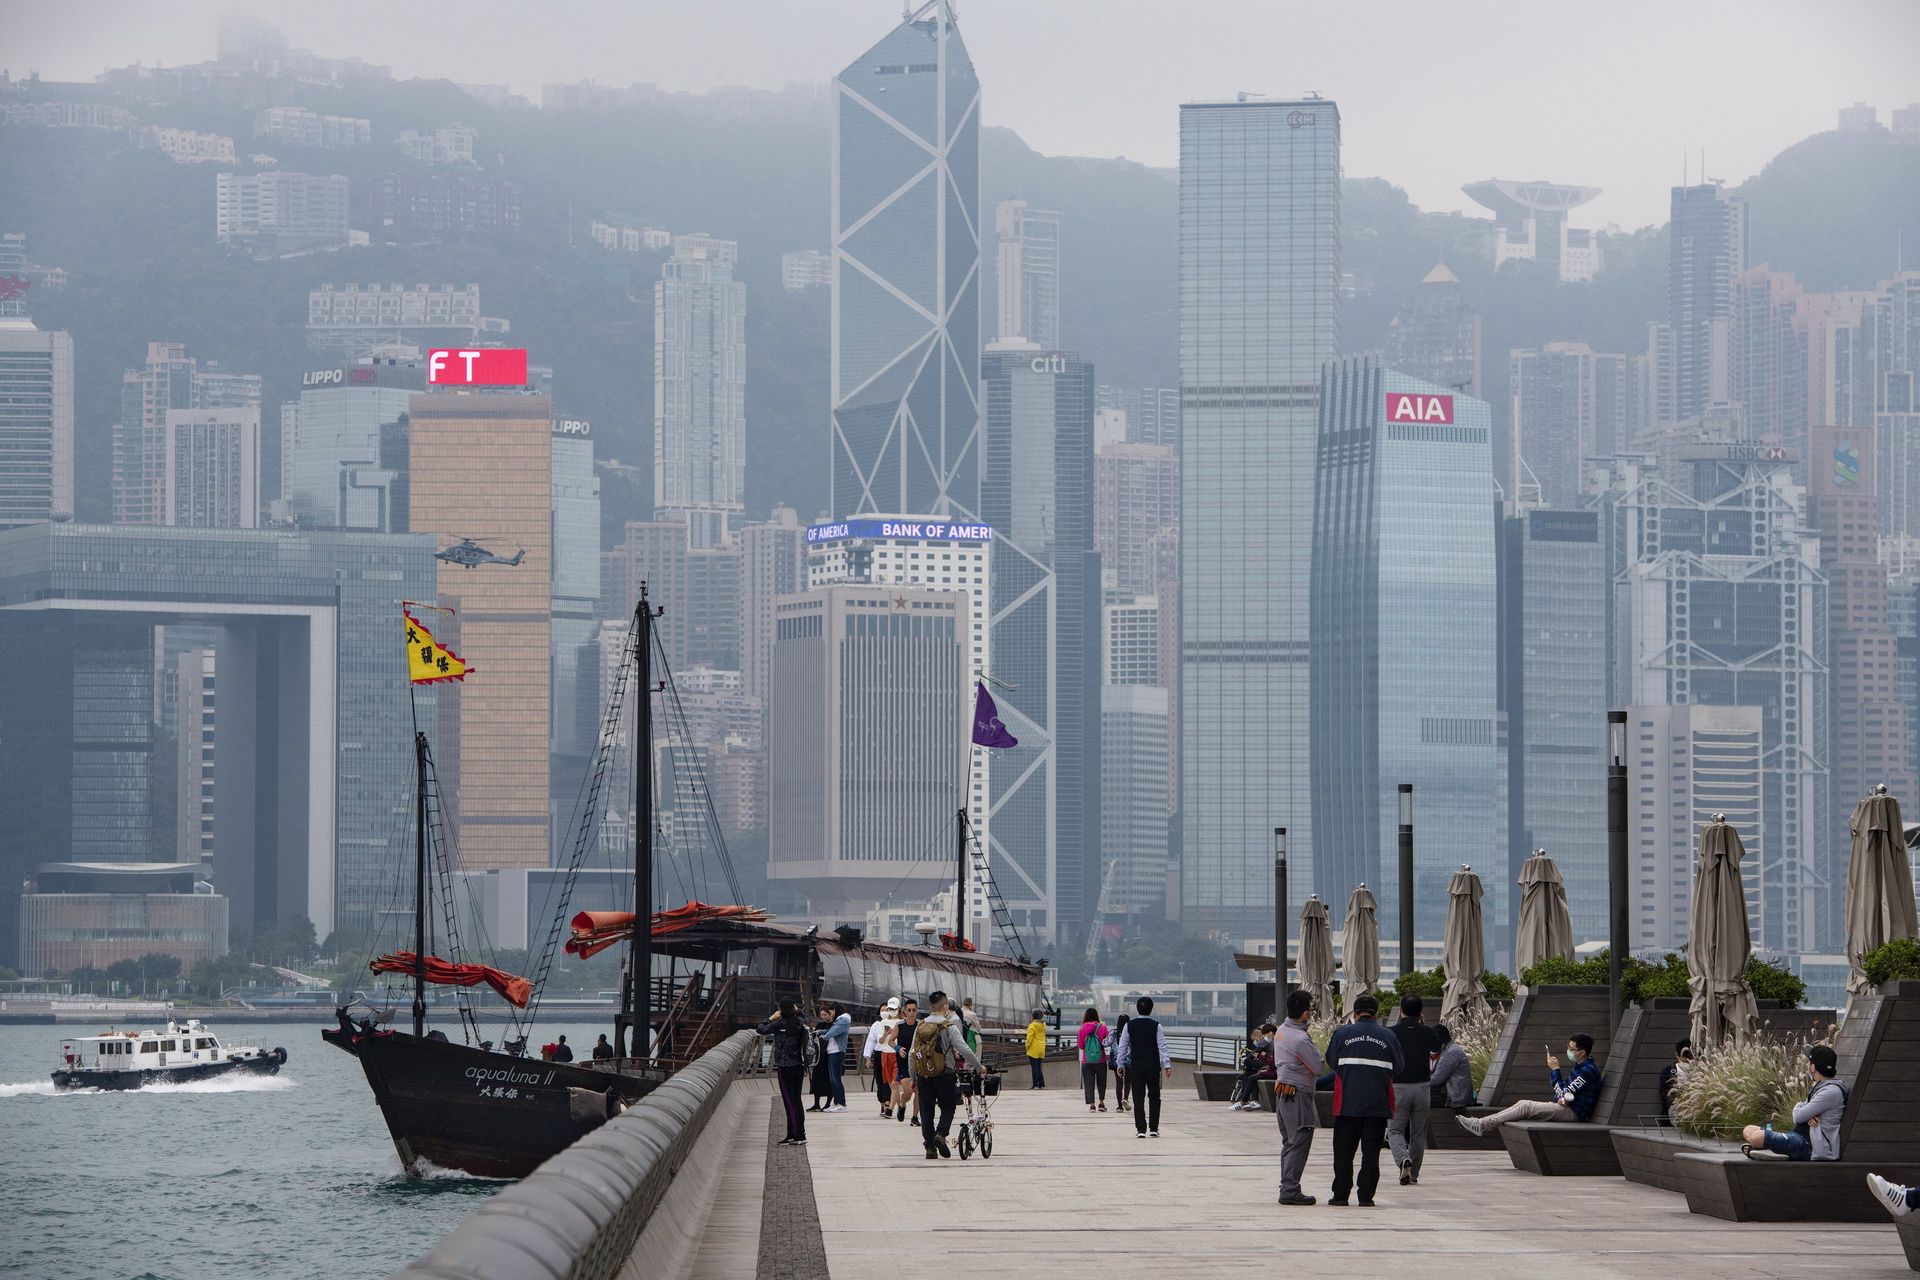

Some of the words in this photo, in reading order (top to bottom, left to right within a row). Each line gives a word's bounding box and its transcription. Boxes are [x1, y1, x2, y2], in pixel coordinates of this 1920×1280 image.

[303, 369, 343, 385] LIPPO
[1395, 396, 1446, 421] AIA
[551, 420, 590, 435] LIPPO
[1727, 446, 1764, 459] HSBC
[807, 529, 817, 541] OF
[818, 524, 849, 540] AMERICA
[882, 523, 922, 537] BANK
[925, 524, 944, 538] OF
[948, 525, 992, 539] AMERI
[1344, 1035, 1365, 1046] General
[1365, 1035, 1388, 1050] Security
[465, 1065, 540, 1087] aqualuna
